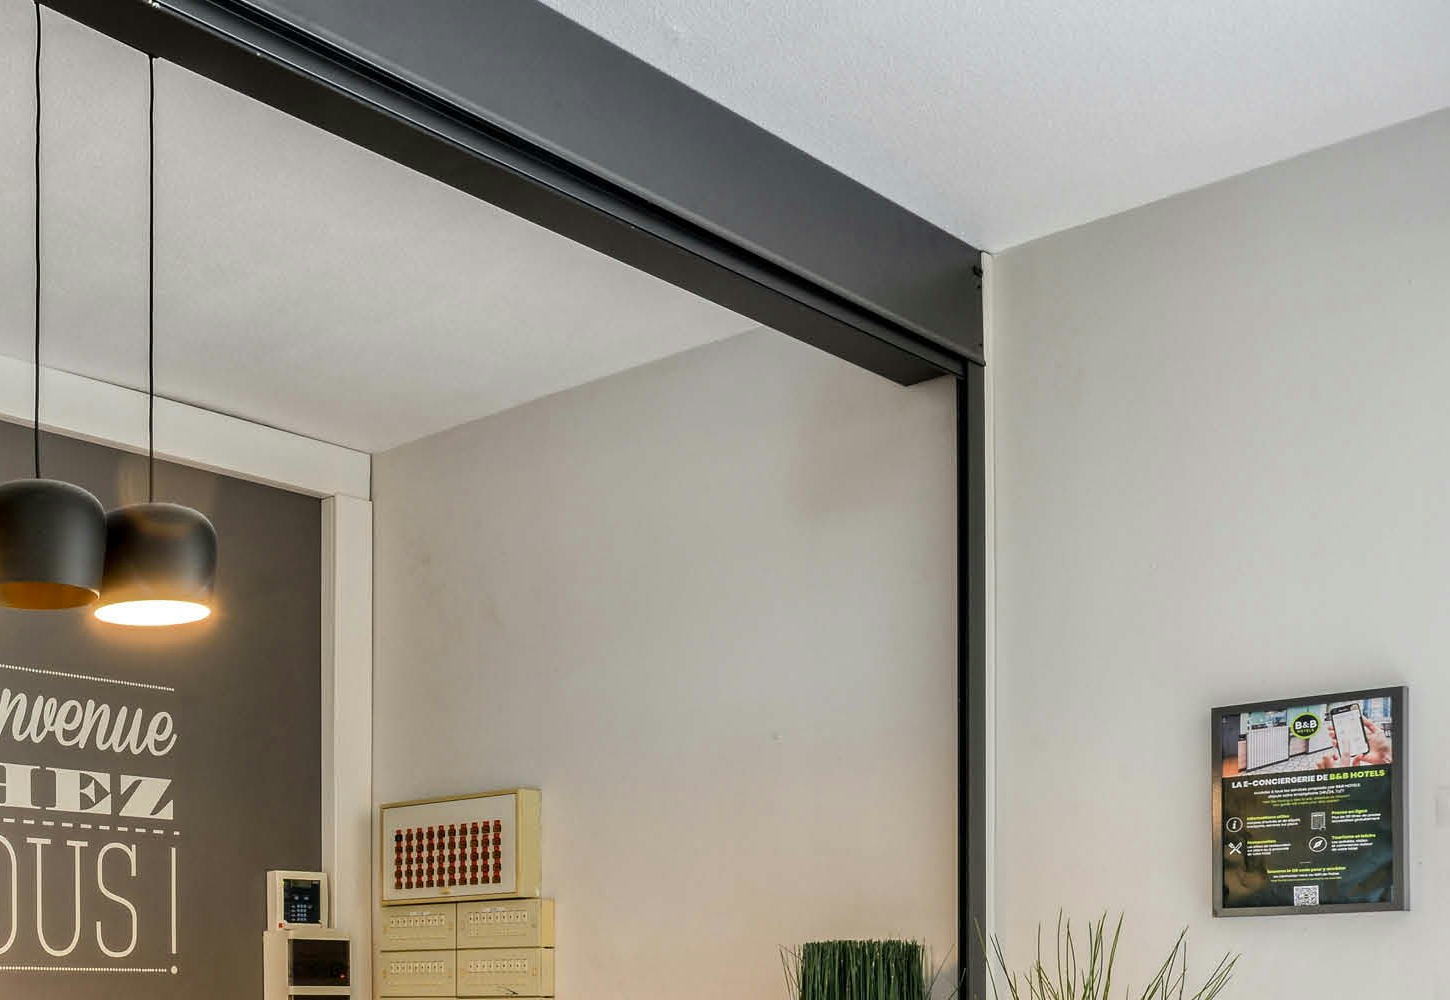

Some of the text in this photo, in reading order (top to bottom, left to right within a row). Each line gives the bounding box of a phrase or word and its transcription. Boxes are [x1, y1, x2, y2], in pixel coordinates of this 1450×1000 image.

[1295, 720, 1317, 730] B&B
[1243, 775, 1315, 788] E-CONCIERGERIE
[1330, 772, 1349, 780] B&B
[1350, 769, 1386, 778] HOTELS
